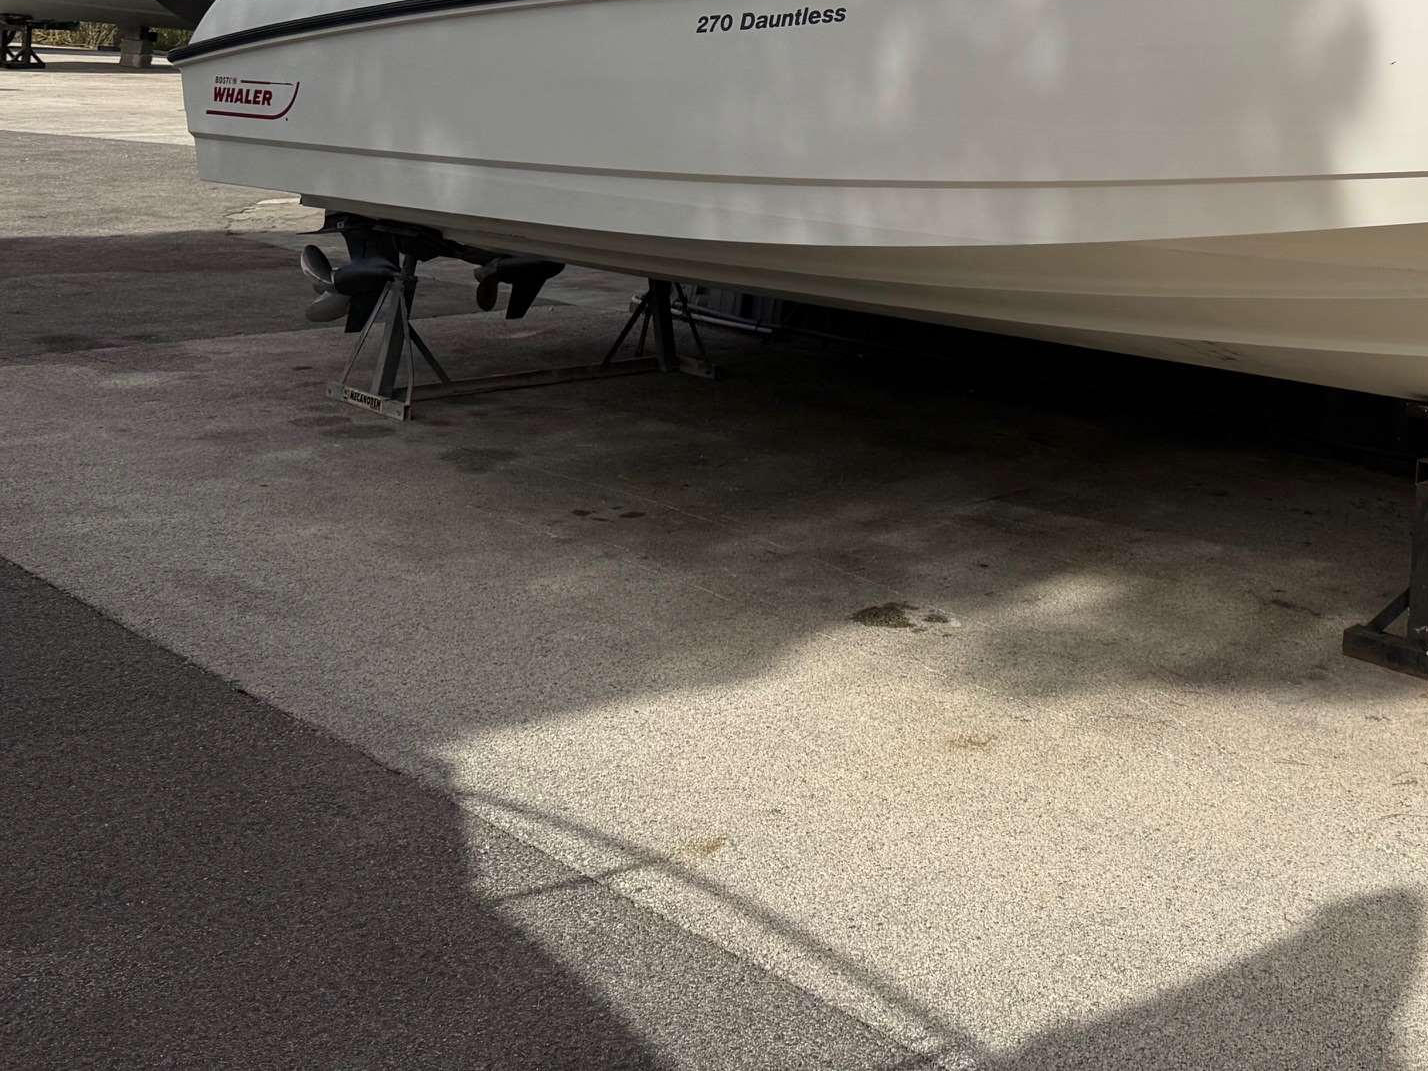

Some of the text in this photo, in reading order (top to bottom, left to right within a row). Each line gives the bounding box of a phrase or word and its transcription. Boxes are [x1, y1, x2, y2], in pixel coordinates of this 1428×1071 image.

[696, 7, 847, 33] 270 Dauntless
[213, 86, 273, 106] WHALER
